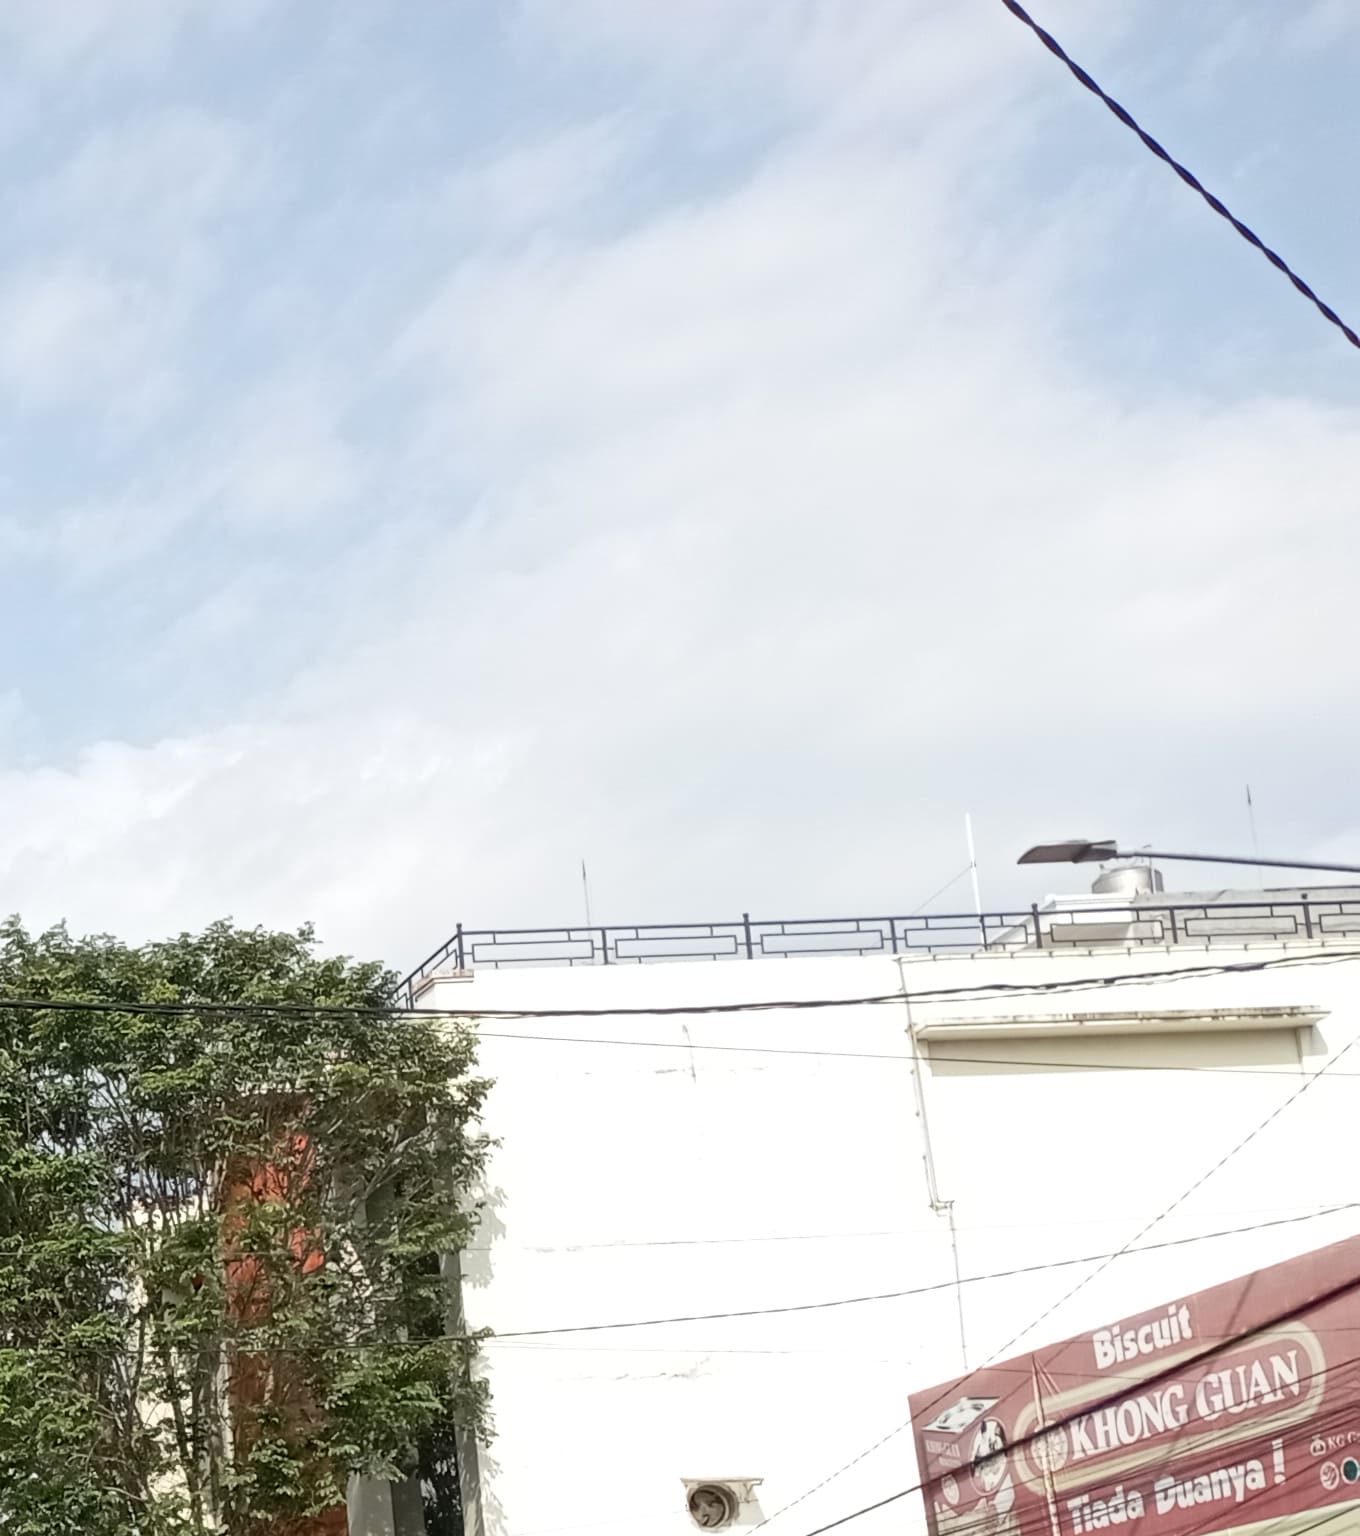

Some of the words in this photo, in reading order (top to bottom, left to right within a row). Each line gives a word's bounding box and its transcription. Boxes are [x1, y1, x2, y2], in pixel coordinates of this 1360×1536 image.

[1092, 1303, 1192, 1370] Biscuit
[1069, 1384, 1188, 1460] KHONG
[1195, 1350, 1301, 1421] GUAN
[1067, 1485, 1146, 1536] Tiada
[1154, 1459, 1266, 1516] Duanya
